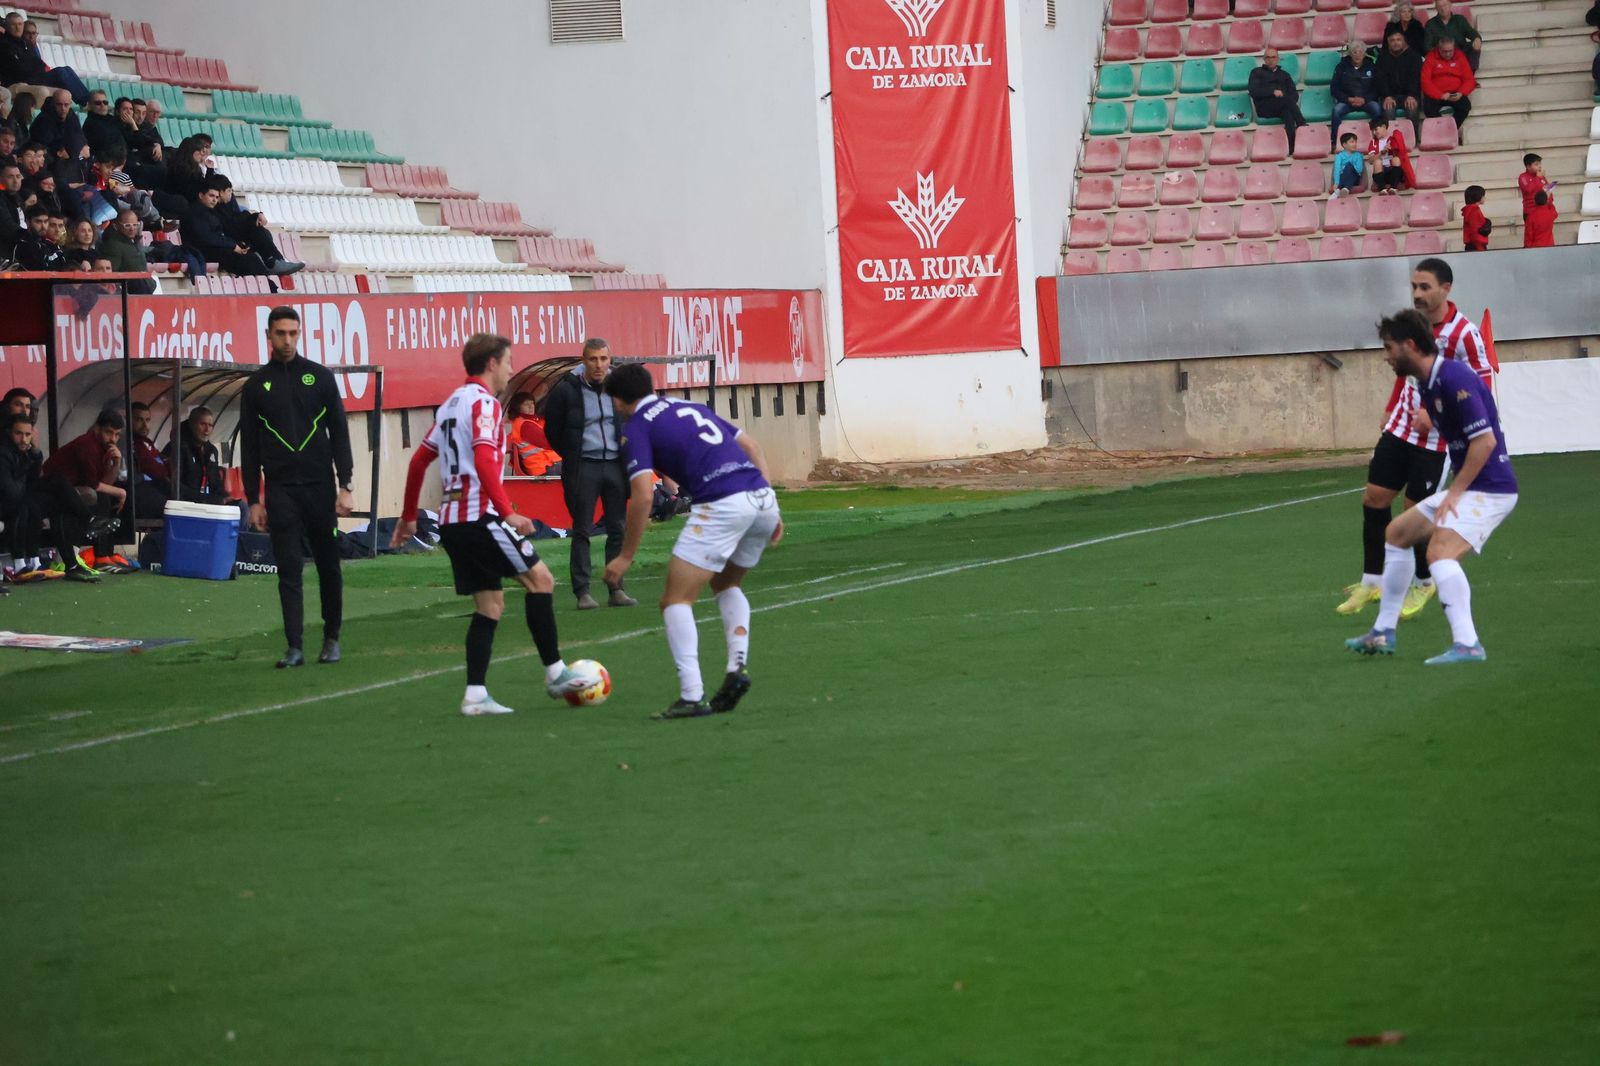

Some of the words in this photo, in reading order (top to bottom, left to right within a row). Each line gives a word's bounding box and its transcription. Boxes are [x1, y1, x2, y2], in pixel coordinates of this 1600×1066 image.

[845, 46, 905, 71] CAJA
[909, 43, 992, 69] RURAL
[872, 75, 894, 89] DE
[899, 72, 967, 89] ZAMORA
[856, 258, 917, 283] CAJA
[920, 254, 1002, 280] RURAL
[883, 287, 906, 302] DE
[911, 283, 979, 300] ZAMORA
[386, 295, 498, 350] FABRICACIÓN
[511, 305, 530, 345] DE
[538, 305, 586, 345] STAND
[676, 407, 724, 445] 3
[235, 561, 278, 574] macron
